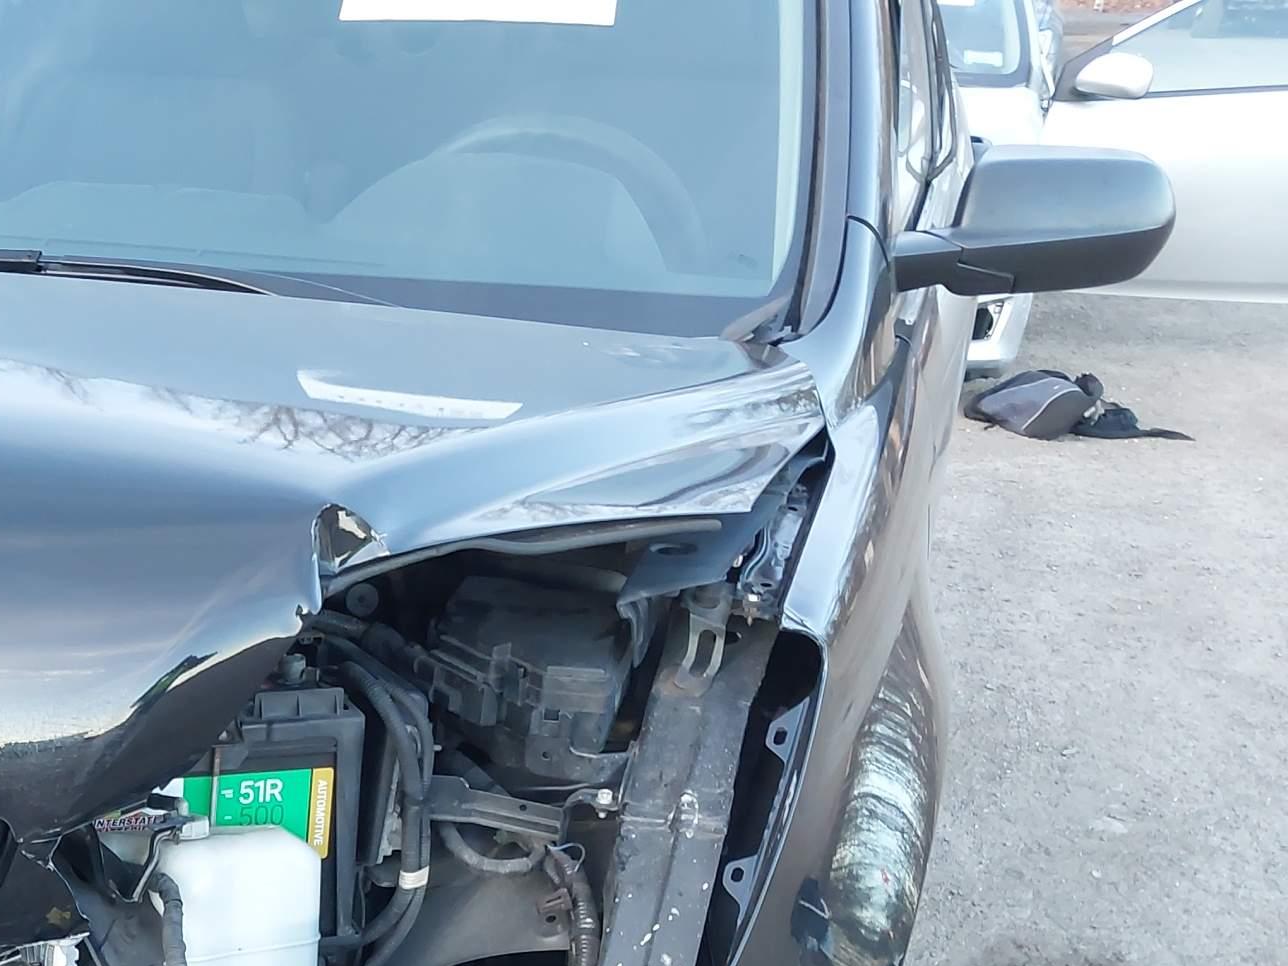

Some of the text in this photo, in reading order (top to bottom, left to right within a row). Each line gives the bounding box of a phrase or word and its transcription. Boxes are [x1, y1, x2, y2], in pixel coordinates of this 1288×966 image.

[238, 778, 284, 805] 51R
[239, 804, 284, 826] 500
[313, 779, 329, 847] AUTOMOTIVE
